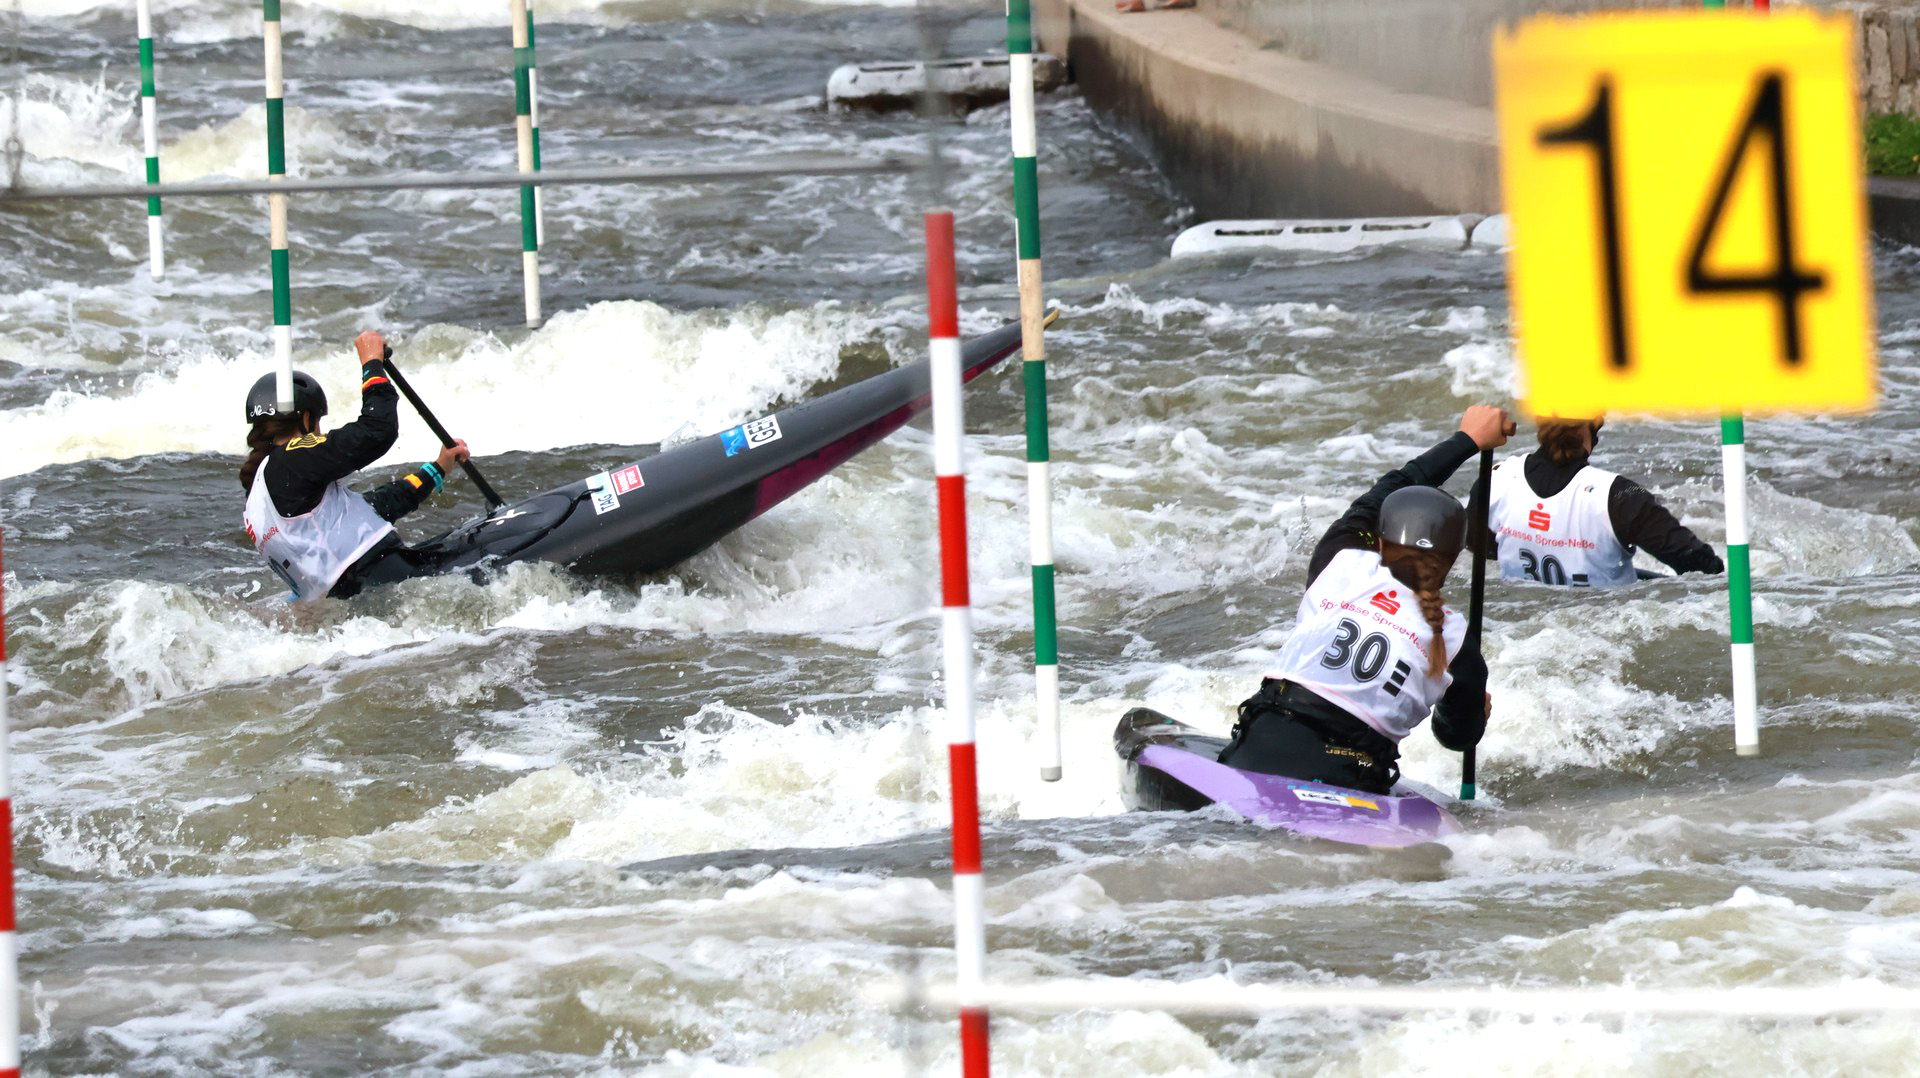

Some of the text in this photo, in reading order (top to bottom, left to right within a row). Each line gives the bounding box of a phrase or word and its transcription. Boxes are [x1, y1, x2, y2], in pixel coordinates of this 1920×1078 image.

[1535, 69, 1828, 370] 14
[1518, 547, 1567, 586] 30
[1320, 617, 1391, 683] 30
